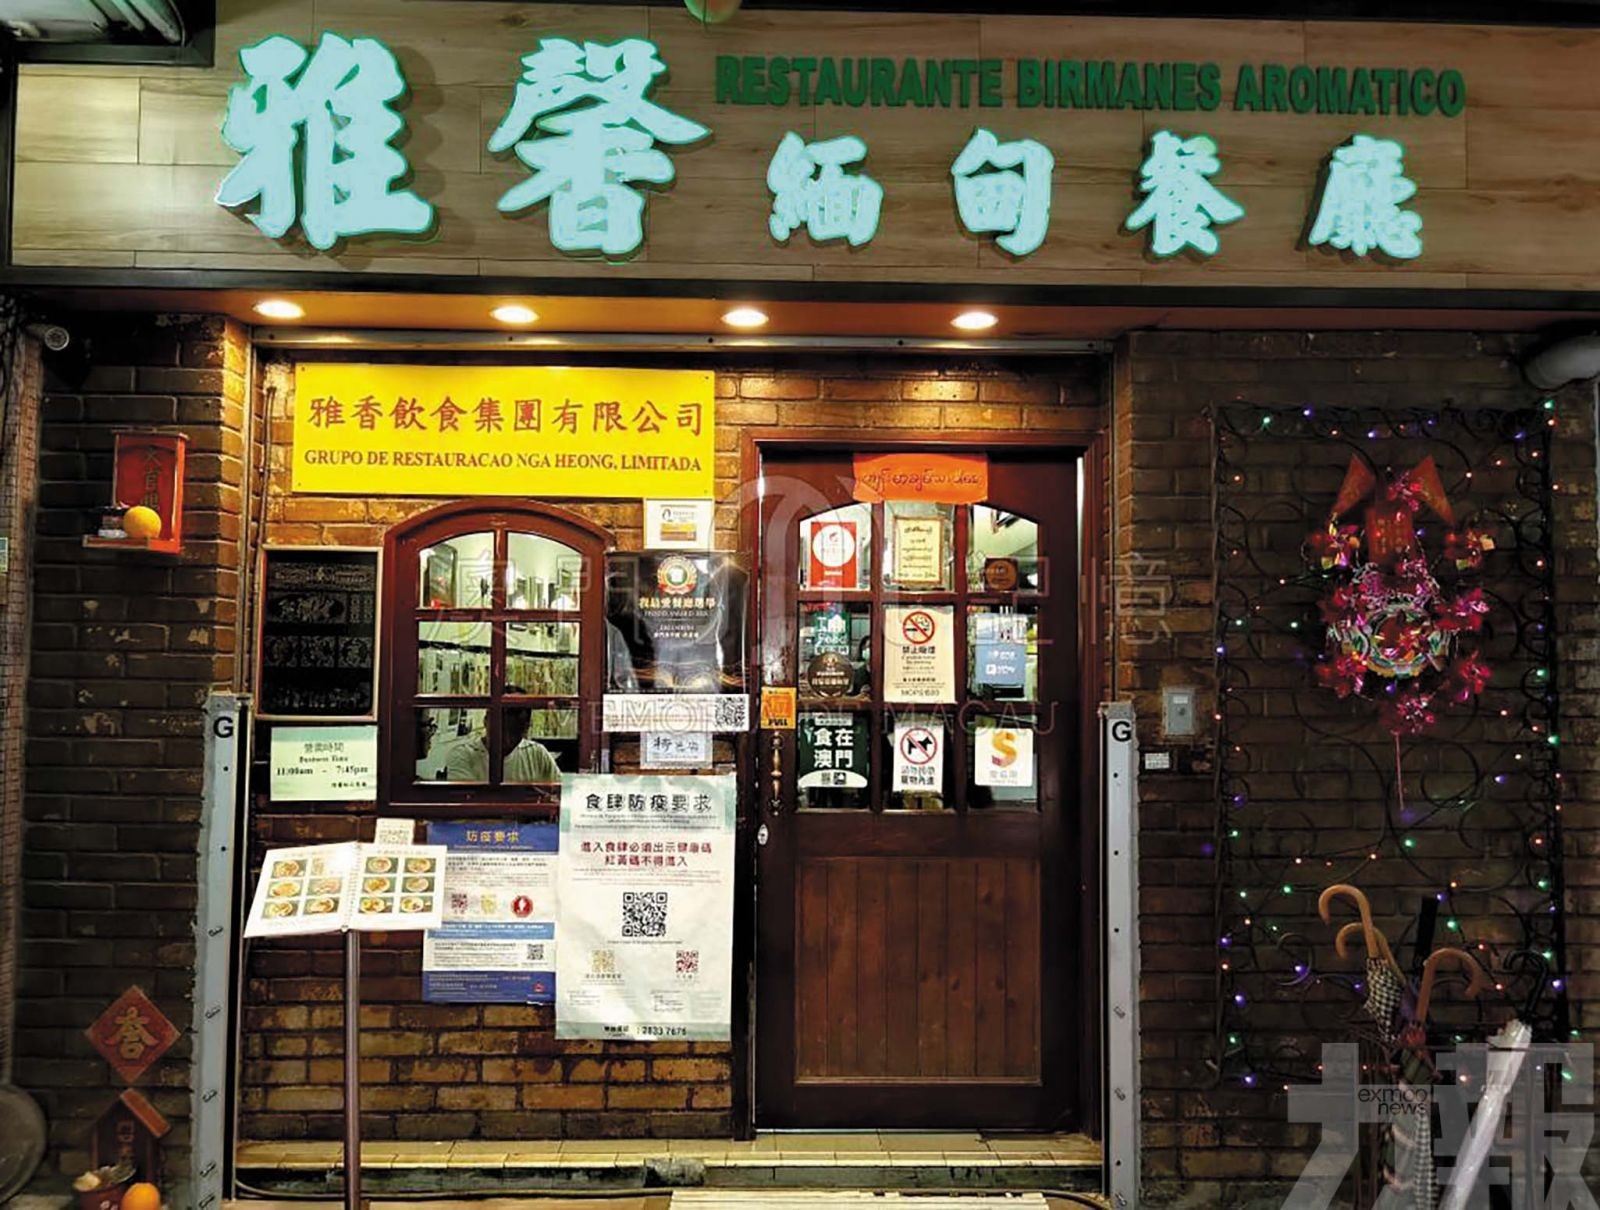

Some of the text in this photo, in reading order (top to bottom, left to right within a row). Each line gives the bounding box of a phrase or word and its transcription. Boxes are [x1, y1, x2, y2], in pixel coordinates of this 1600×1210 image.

[715, 55, 1467, 117] RESTAURANTE BIRMANES AROMATICO
[214, 31, 1424, 263] 雅馨 緬甸餐廳
[307, 396, 703, 437] 雅香飲食集團有限公司
[304, 450, 363, 466] GRUPO
[367, 451, 389, 466] DE
[393, 451, 513, 468] RESTAURACAO
[516, 453, 551, 468] NGA
[621, 456, 702, 471] LIMITADA
[213, 715, 234, 738] G
[813, 727, 854, 747] 食在
[1112, 721, 1132, 742] G
[813, 748, 853, 769] 澳門
[586, 793, 713, 813] 食肆防疫要求
[580, 841, 713, 855] 進入食肆必須出示健康碼
[604, 854, 689, 867] 紅黃碼不得進入
